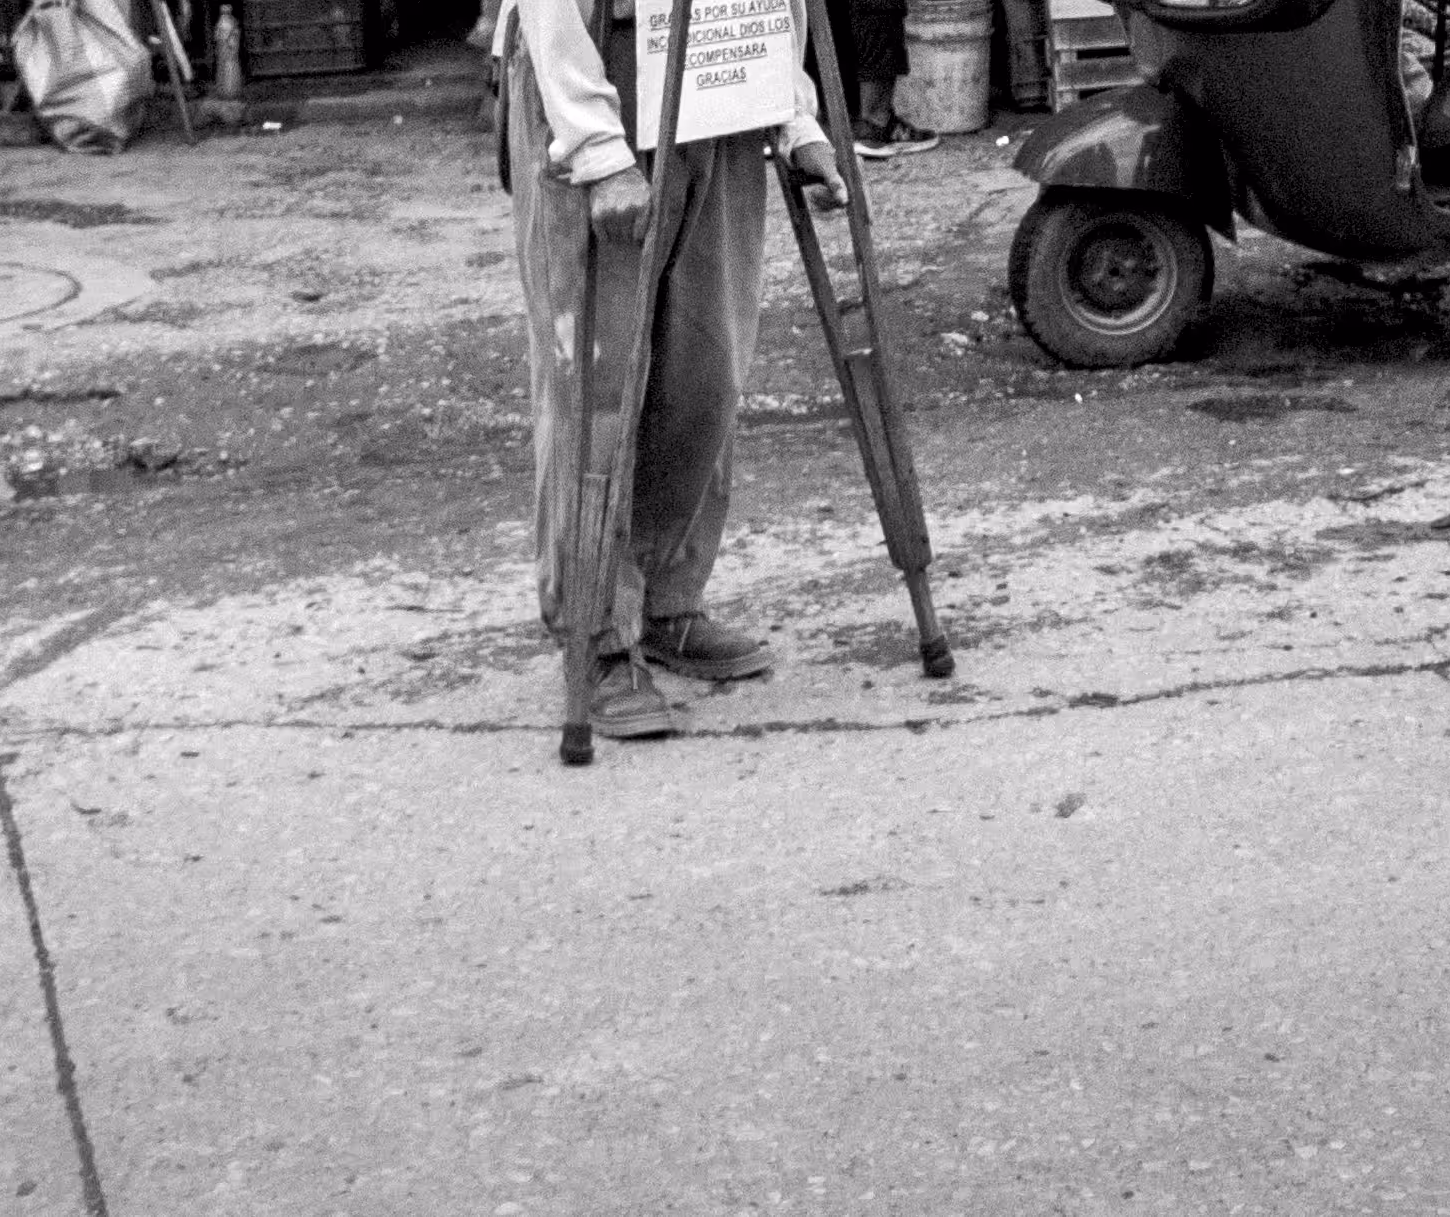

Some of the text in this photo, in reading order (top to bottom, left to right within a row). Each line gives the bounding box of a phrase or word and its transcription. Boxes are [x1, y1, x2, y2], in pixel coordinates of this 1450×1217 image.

[704, 4, 728, 19] POR
[731, 1, 746, 16] SU
[647, 16, 791, 52] INCICIONAL DIOS LOS
[689, 42, 768, 66] COMPENSARA
[696, 66, 747, 87] GRACIAS
